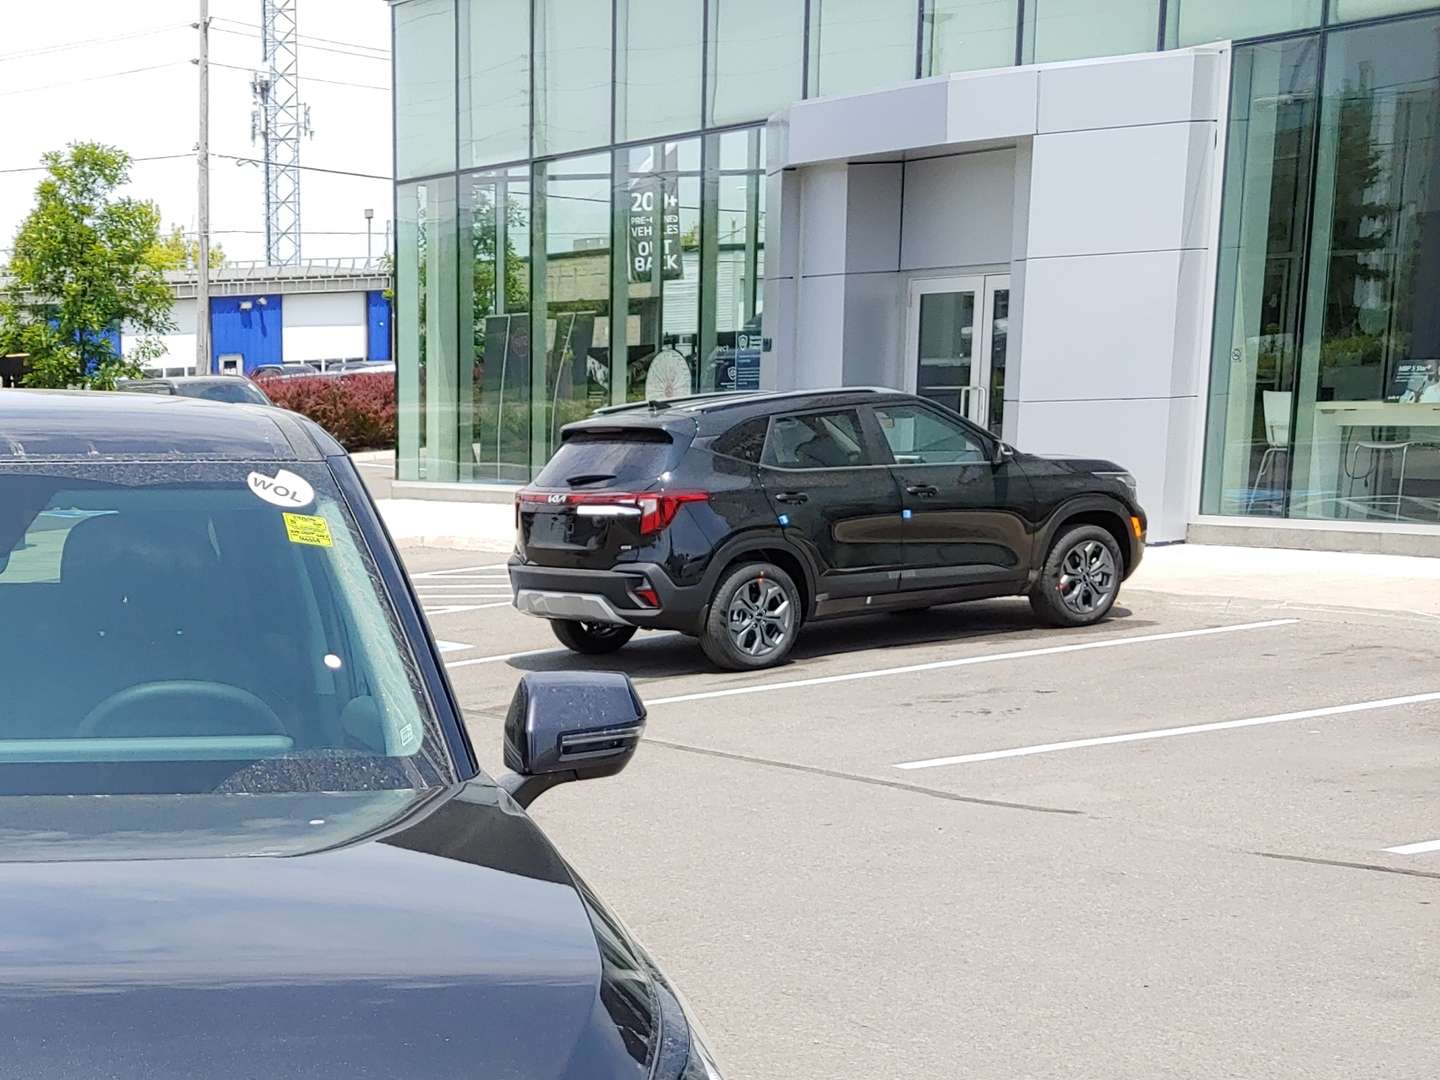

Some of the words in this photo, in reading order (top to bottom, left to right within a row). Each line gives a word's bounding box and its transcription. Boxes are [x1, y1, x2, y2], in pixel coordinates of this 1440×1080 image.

[631, 191, 678, 212] 20+
[630, 214, 678, 225] PRE-NED
[637, 239, 672, 256] OT
[634, 254, 678, 272] BAK
[253, 477, 302, 503] WOL
